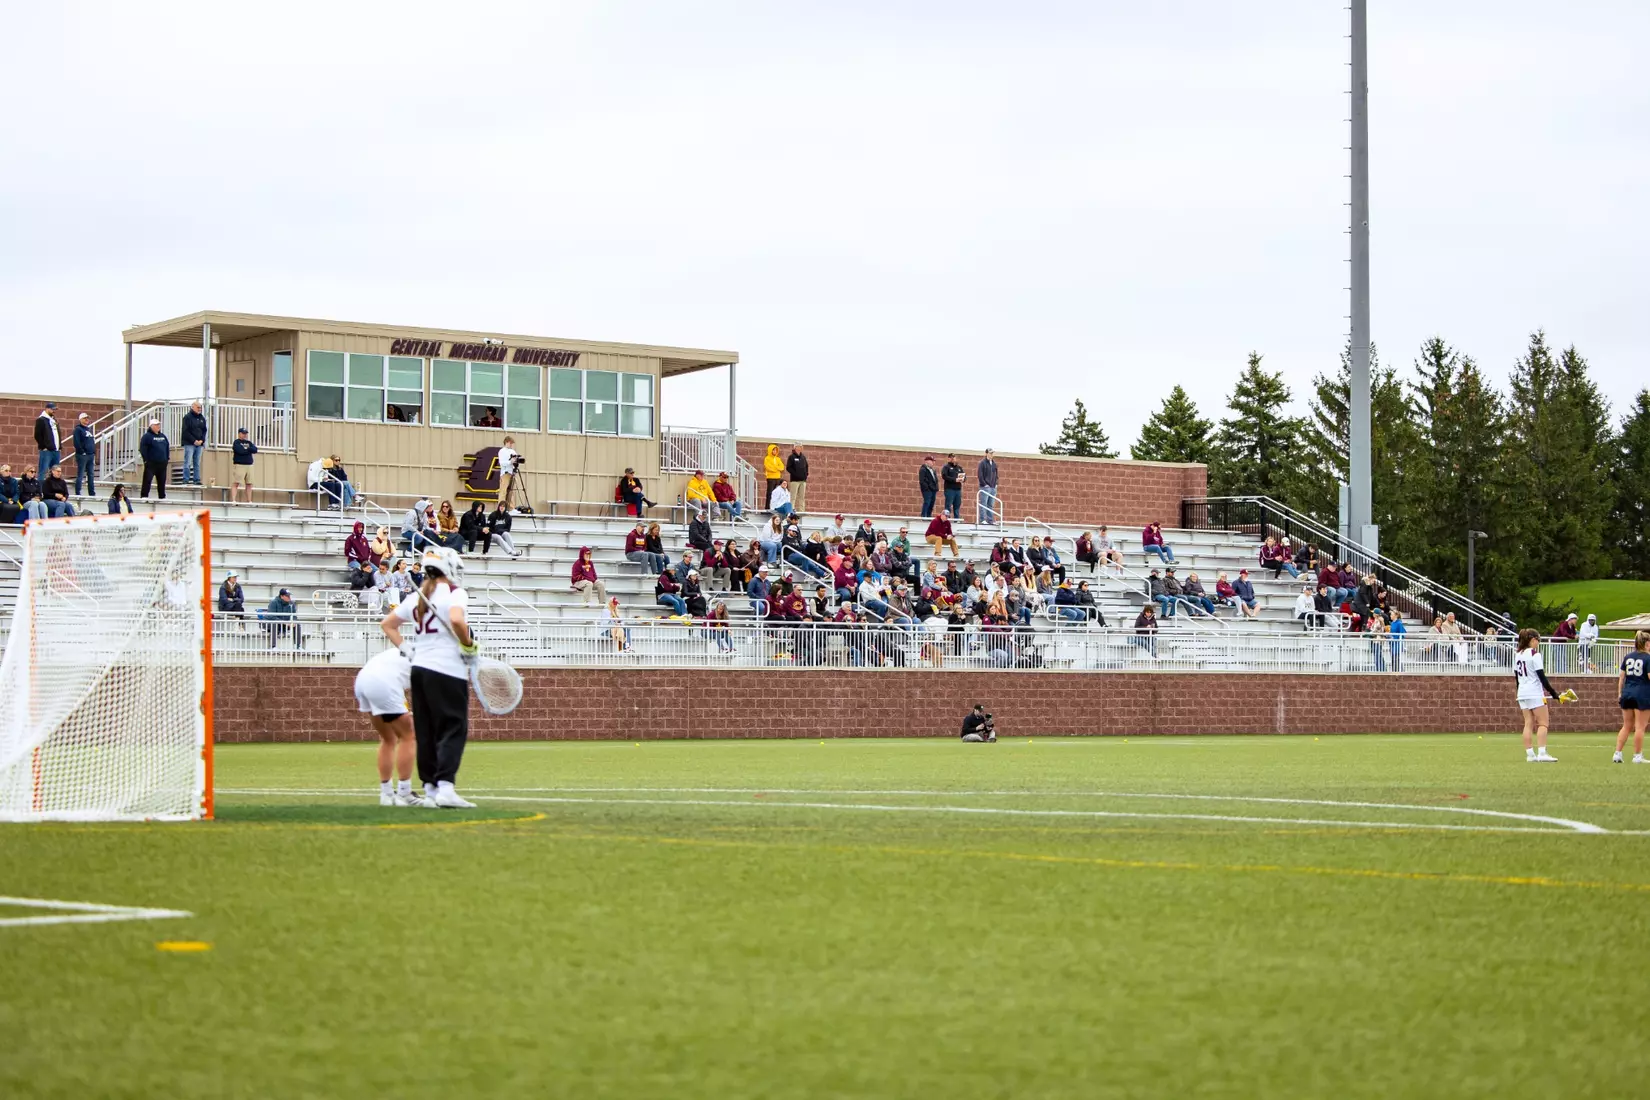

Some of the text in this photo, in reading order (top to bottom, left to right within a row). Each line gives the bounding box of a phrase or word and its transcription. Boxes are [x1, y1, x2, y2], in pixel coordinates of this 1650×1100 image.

[390, 338, 581, 367] CENTRAL MICHIGAN UNIVERSITY
[1516, 659, 1528, 677] 31
[1625, 658, 1644, 677] 29
